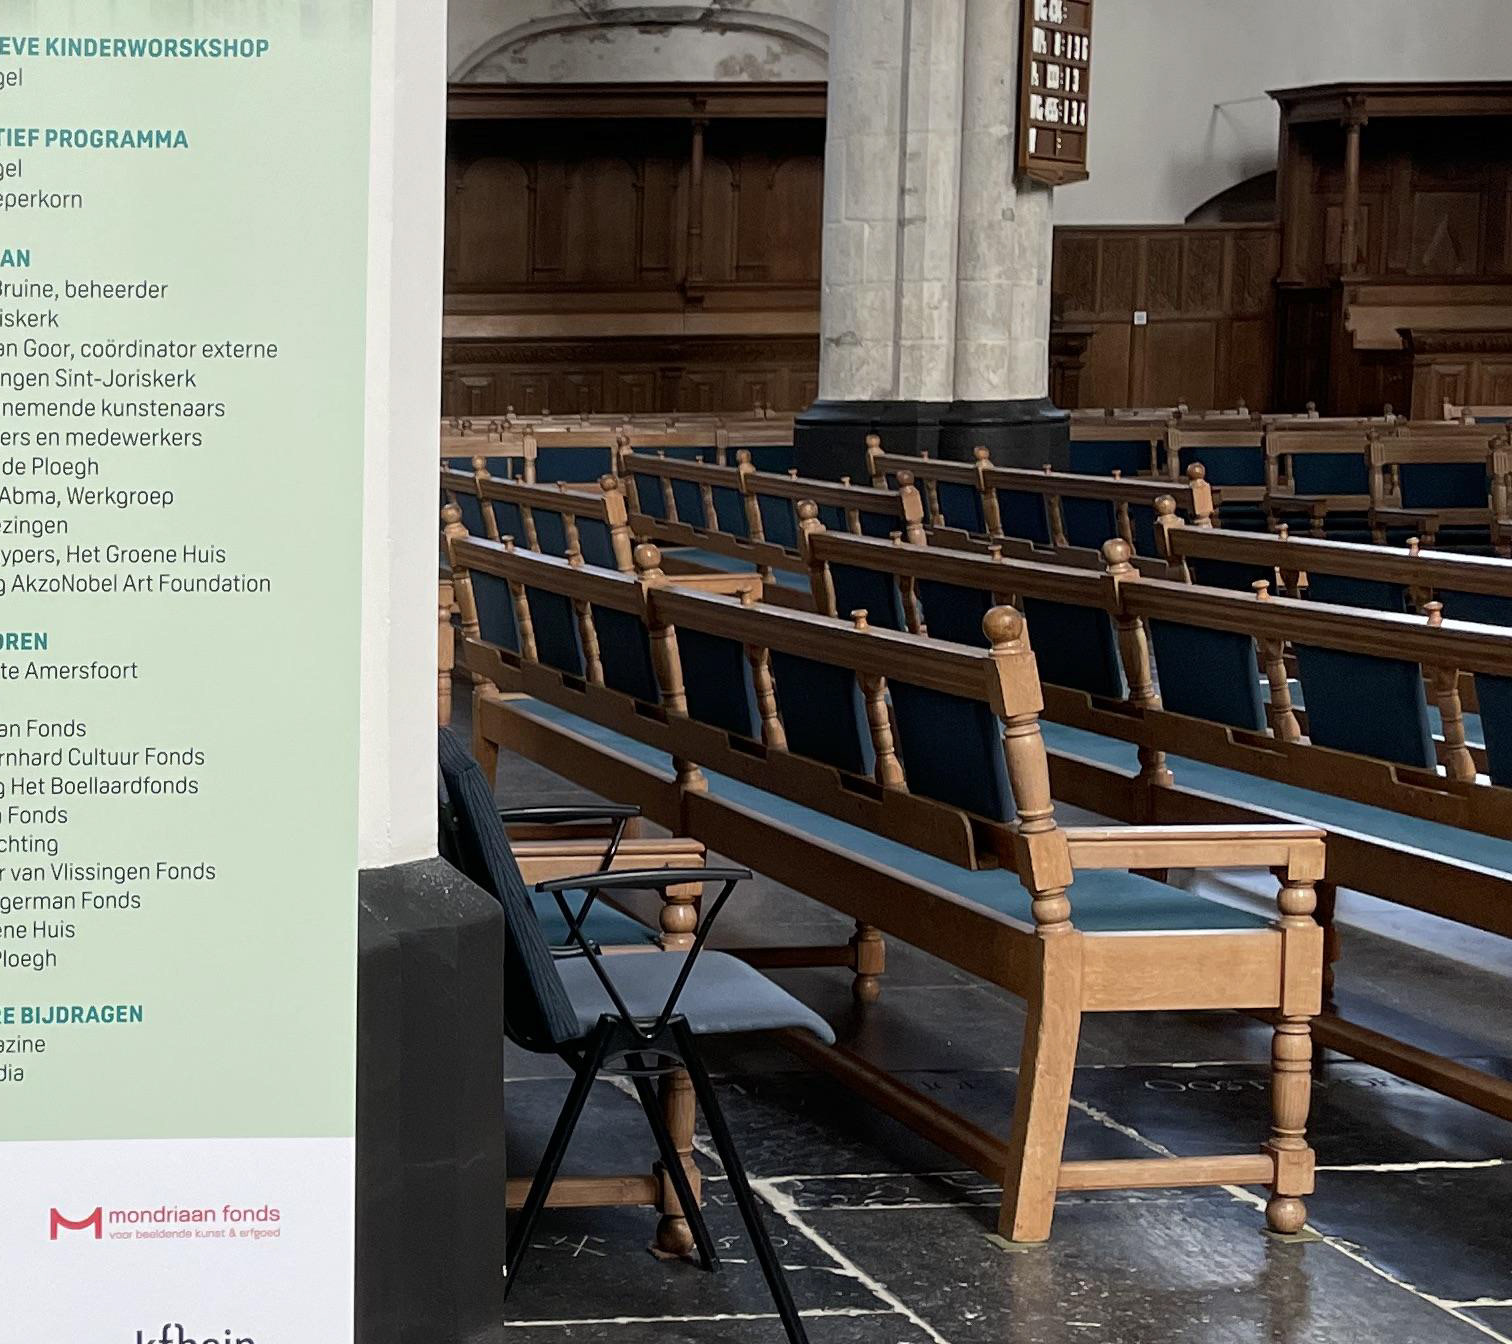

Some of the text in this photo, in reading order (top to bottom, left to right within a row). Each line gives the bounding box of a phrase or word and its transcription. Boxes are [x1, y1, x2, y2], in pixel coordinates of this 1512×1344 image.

[46, 37, 269, 58] KINDERWORSKSHOP
[45, 129, 188, 149] PROGRAMMA
[24, 338, 74, 361] Goor,
[81, 339, 197, 358] coördinator
[202, 341, 277, 358] externe
[102, 398, 225, 417] kunstenaars
[11, 574, 117, 592] AkzoNobel
[123, 574, 153, 592] Art
[160, 574, 270, 592] Foundation
[24, 661, 138, 679] Amersfoort
[9, 806, 67, 824] Fonds
[10, 867, 44, 881] van
[51, 862, 150, 884] Vlissingen
[157, 862, 215, 880] Fonds
[21, 1005, 143, 1024] BIJDRAGEN
[109, 1205, 280, 1223] mondriaan fonds
[229, 1228, 236, 1238] &
